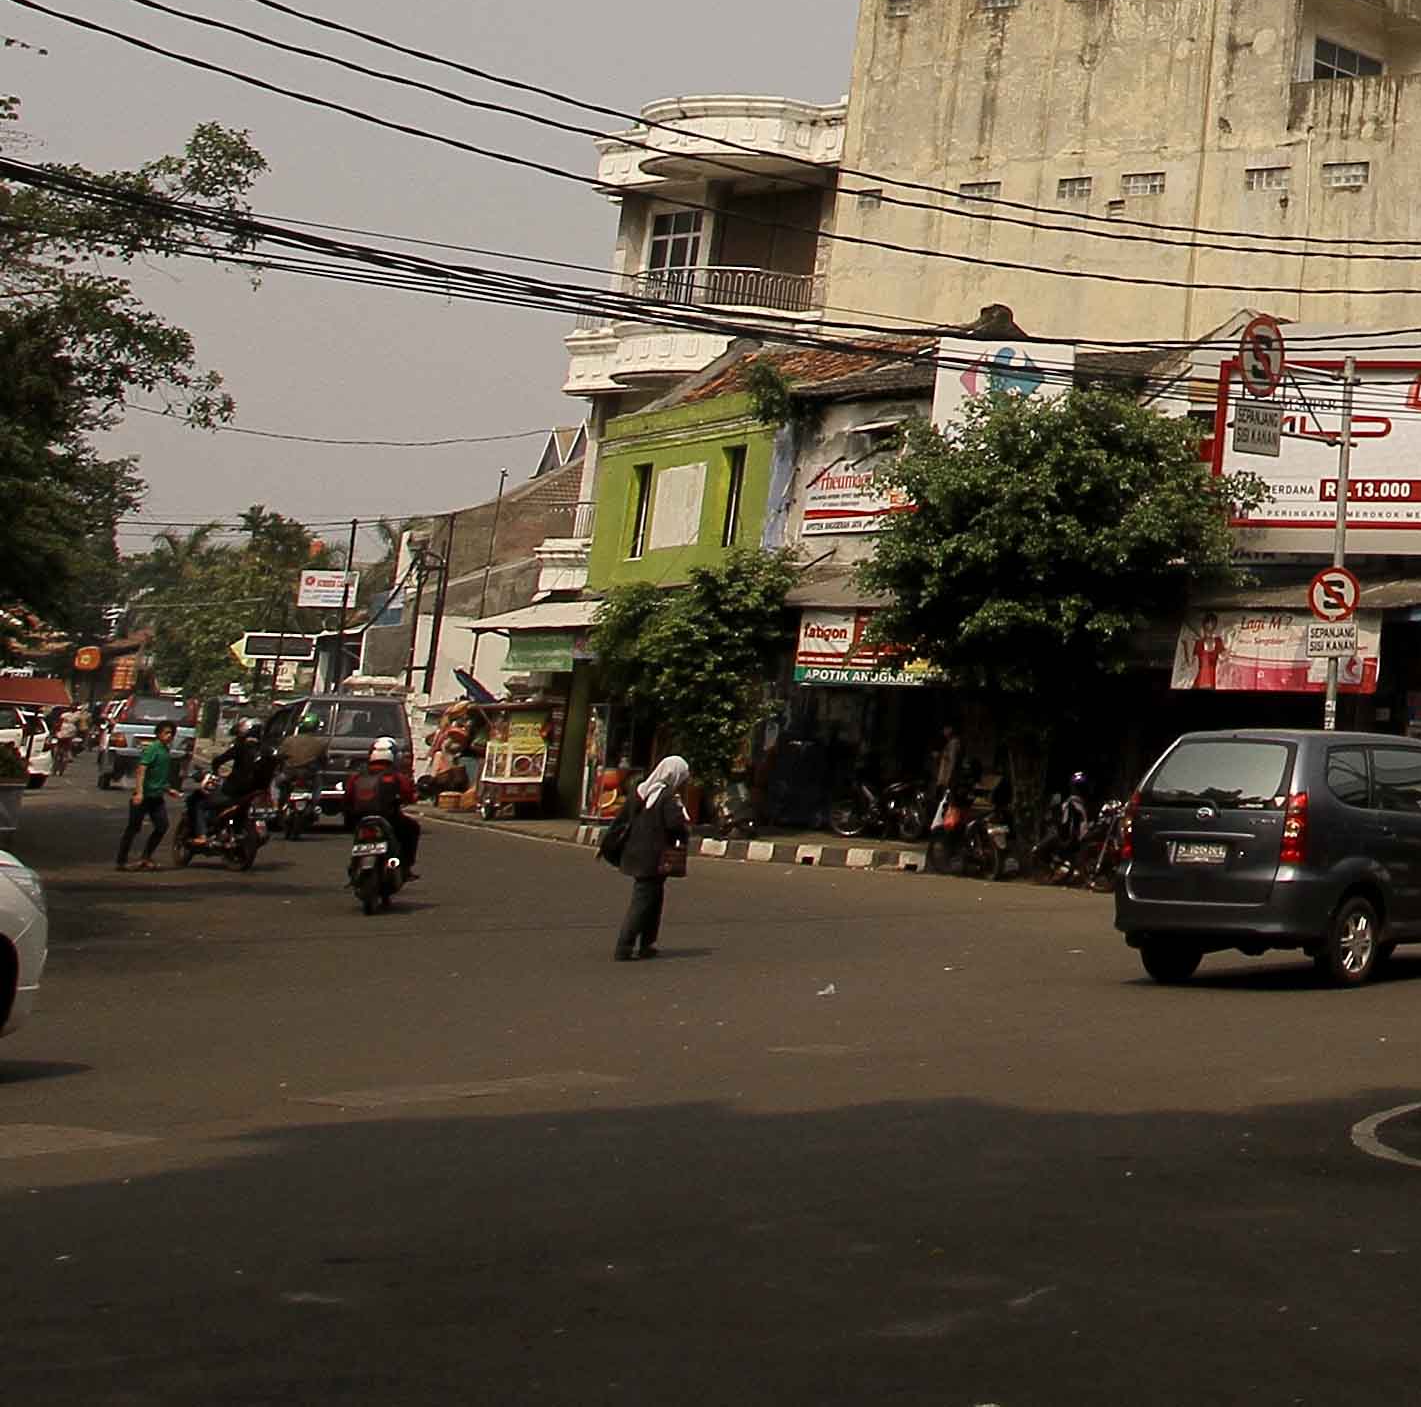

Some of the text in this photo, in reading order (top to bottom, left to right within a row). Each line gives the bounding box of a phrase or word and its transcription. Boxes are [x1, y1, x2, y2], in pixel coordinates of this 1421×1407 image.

[1237, 406, 1279, 429] SEPANJANG
[1240, 617, 1264, 632] Lagi
[1310, 626, 1356, 640] SEPANJANG
[1309, 640, 1356, 652] SISI KANAN
[804, 668, 850, 682] APOTIK
